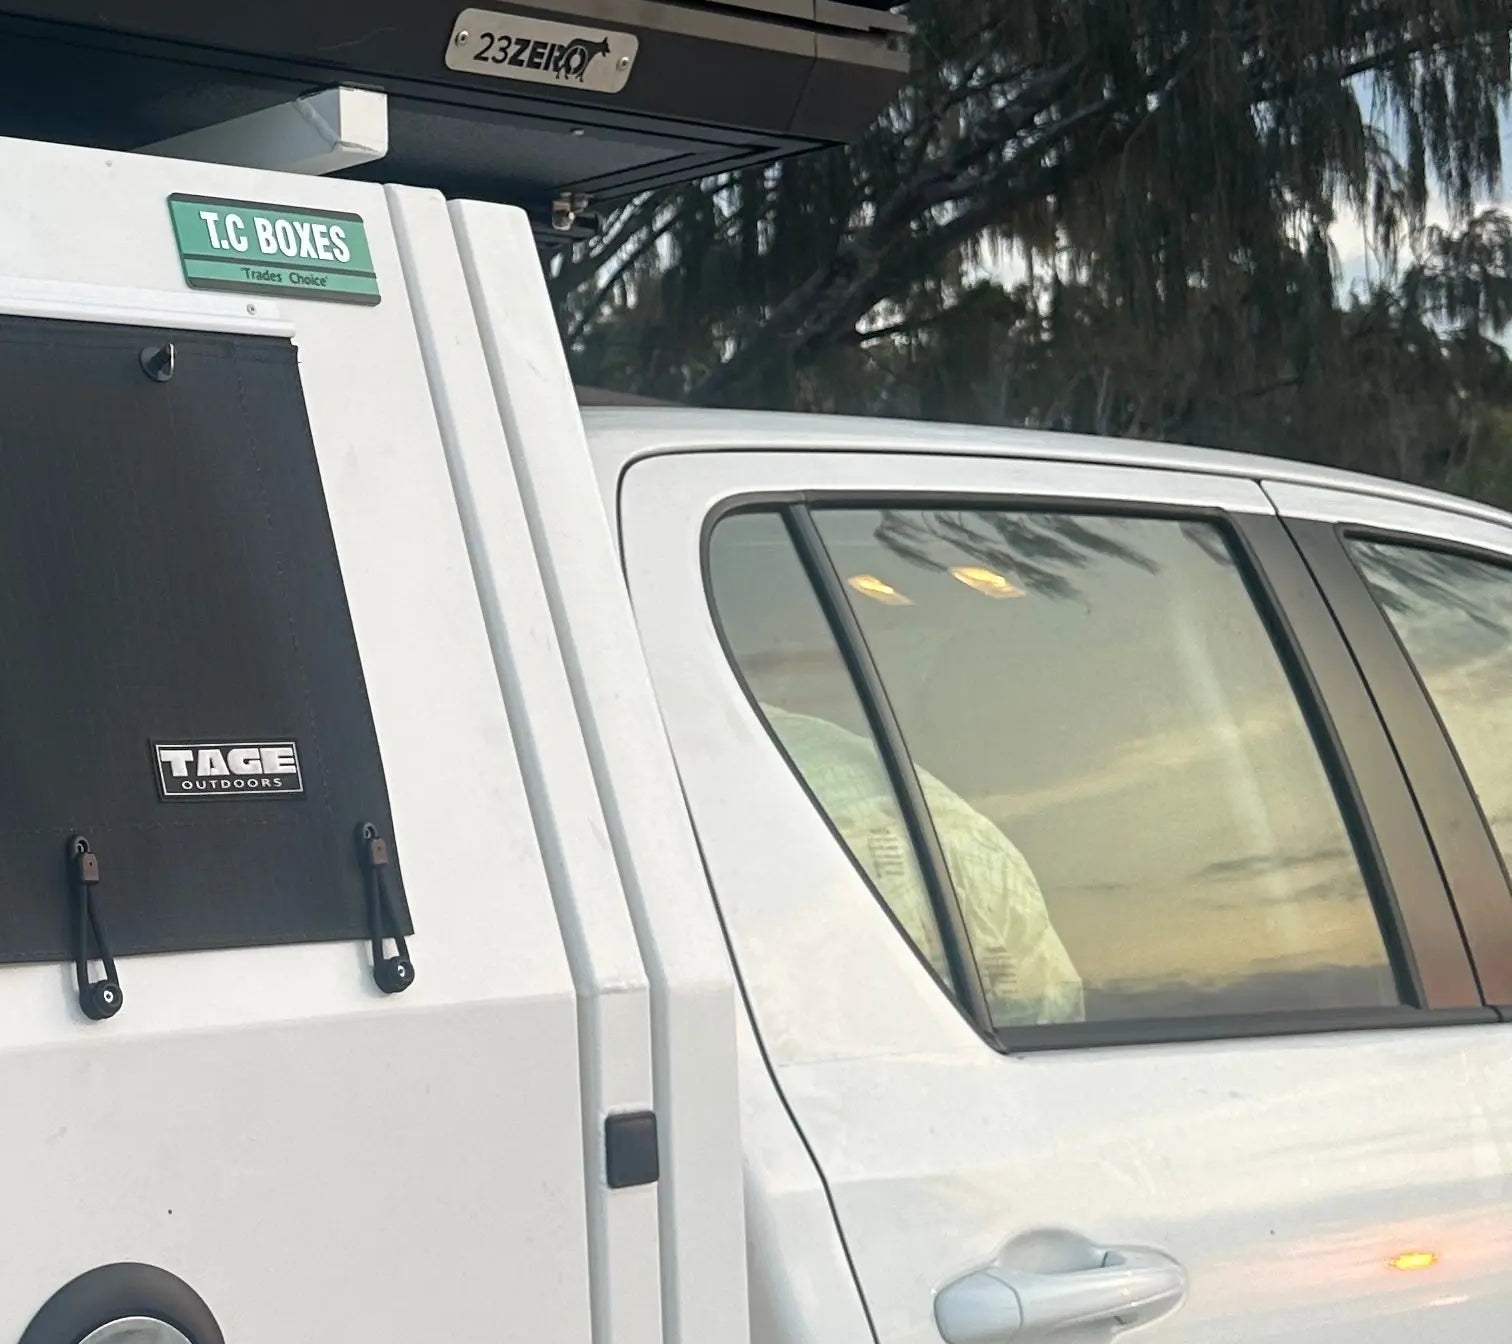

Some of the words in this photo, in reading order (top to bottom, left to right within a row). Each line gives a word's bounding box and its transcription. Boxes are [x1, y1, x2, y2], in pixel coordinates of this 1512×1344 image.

[473, 32, 587, 76] 23ZERO
[199, 211, 248, 252] T.C
[253, 217, 351, 263] BOXES
[159, 747, 297, 777] TAGE
[181, 777, 283, 790] OUTDOORS
